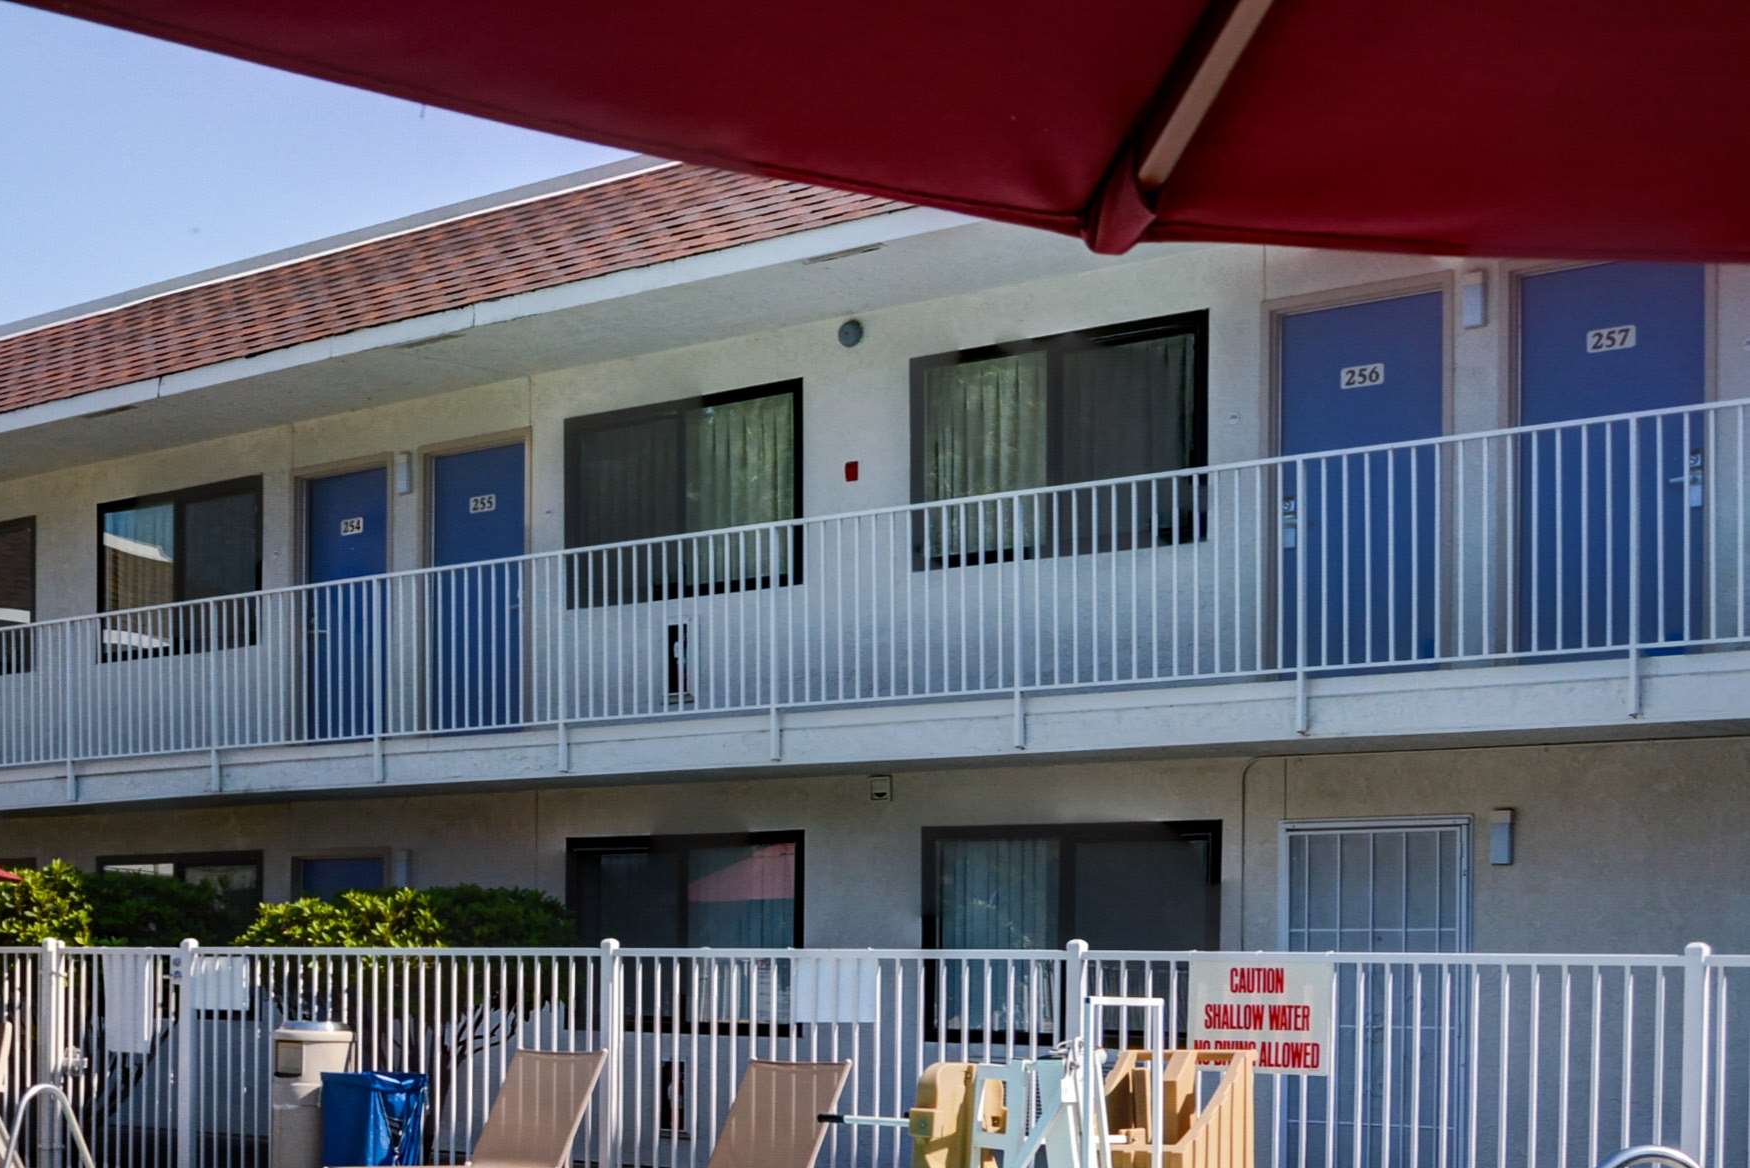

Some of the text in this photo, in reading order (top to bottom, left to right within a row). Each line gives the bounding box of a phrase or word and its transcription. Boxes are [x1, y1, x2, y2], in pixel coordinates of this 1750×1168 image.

[1592, 328, 1630, 350] 257
[1345, 366, 1380, 386] 256
[472, 496, 493, 510] 255
[343, 519, 361, 533] 254
[1229, 967, 1284, 994] CAUTION
[1204, 1003, 1310, 1031] SHALLOW WATER
[1259, 1041, 1320, 1069] ALLOWED
